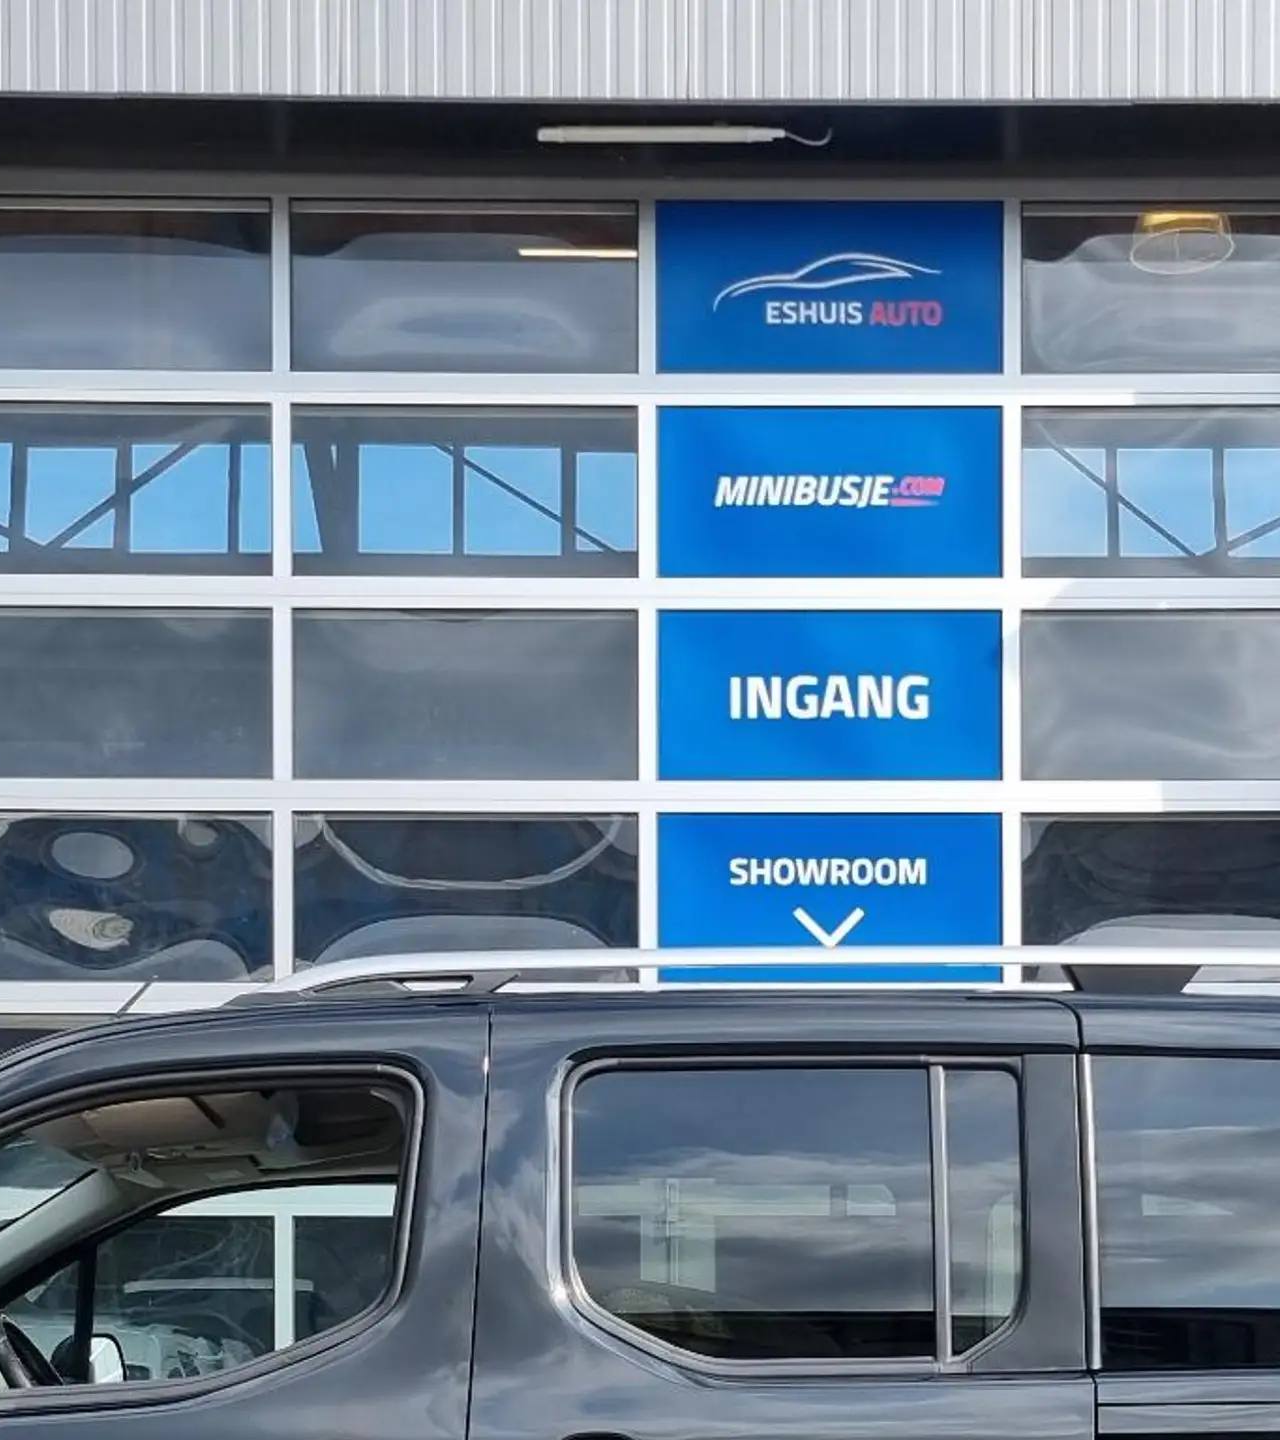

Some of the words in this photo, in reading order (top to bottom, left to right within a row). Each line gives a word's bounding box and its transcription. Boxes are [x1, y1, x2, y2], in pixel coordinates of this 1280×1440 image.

[766, 301, 863, 325] ESHUIS
[869, 301, 944, 326] AUTO
[729, 675, 929, 720] INGANG
[729, 857, 927, 886] SHOWROOM
